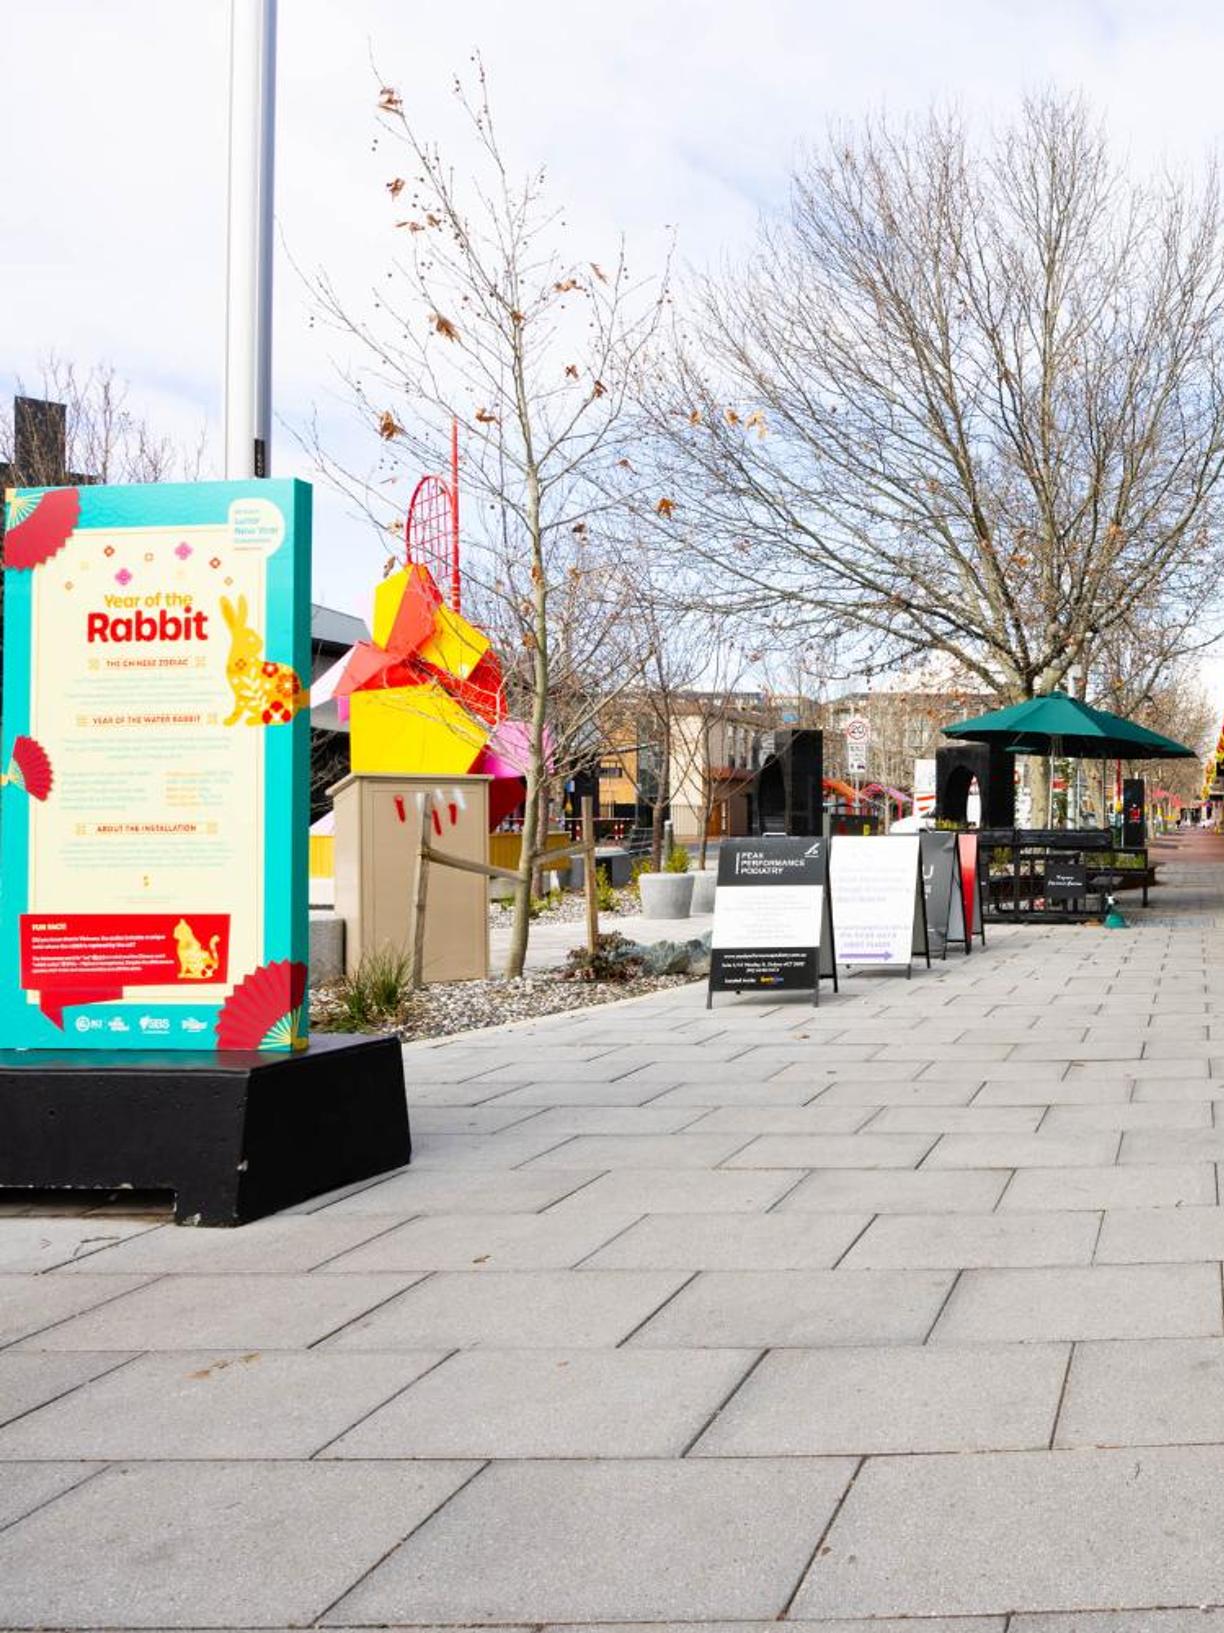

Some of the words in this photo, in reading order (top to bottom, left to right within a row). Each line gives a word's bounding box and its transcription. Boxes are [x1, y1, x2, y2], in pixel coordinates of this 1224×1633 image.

[104, 594, 140, 609] Year
[145, 592, 161, 608] of
[165, 592, 193, 607] the
[87, 606, 209, 643] Rabbit
[106, 659, 121, 668] THE
[122, 659, 156, 667] CHINESE
[159, 658, 189, 667] ZODIAC
[93, 716, 113, 725] YEAR
[115, 716, 125, 724] OF
[128, 715, 142, 724] THE
[143, 715, 170, 723] WATER
[172, 714, 201, 723] RABBIT
[97, 824, 123, 833] ABOUT
[126, 824, 139, 832] THE
[141, 823, 197, 832] INSTALLATION
[741, 859, 806, 867] PERFORMANCE
[741, 867, 784, 875] PODIATRY
